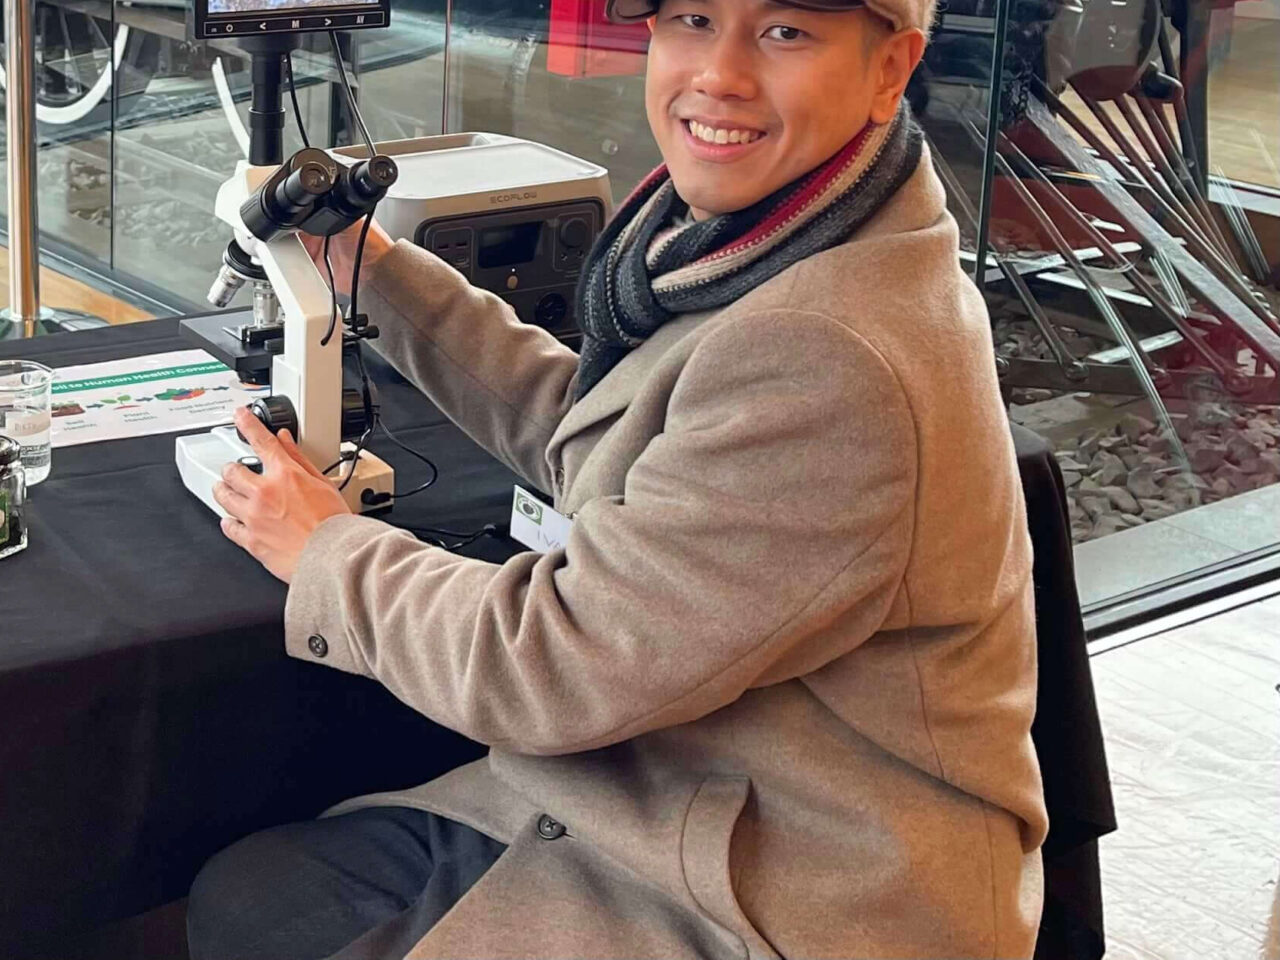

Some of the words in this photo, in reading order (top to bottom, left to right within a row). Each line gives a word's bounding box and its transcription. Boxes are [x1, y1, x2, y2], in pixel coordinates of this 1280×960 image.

[291, 20, 300, 29] M
[356, 15, 365, 25] AV
[490, 192, 537, 204] ECOFLOW
[85, 375, 132, 388] Human
[133, 368, 176, 381] Health
